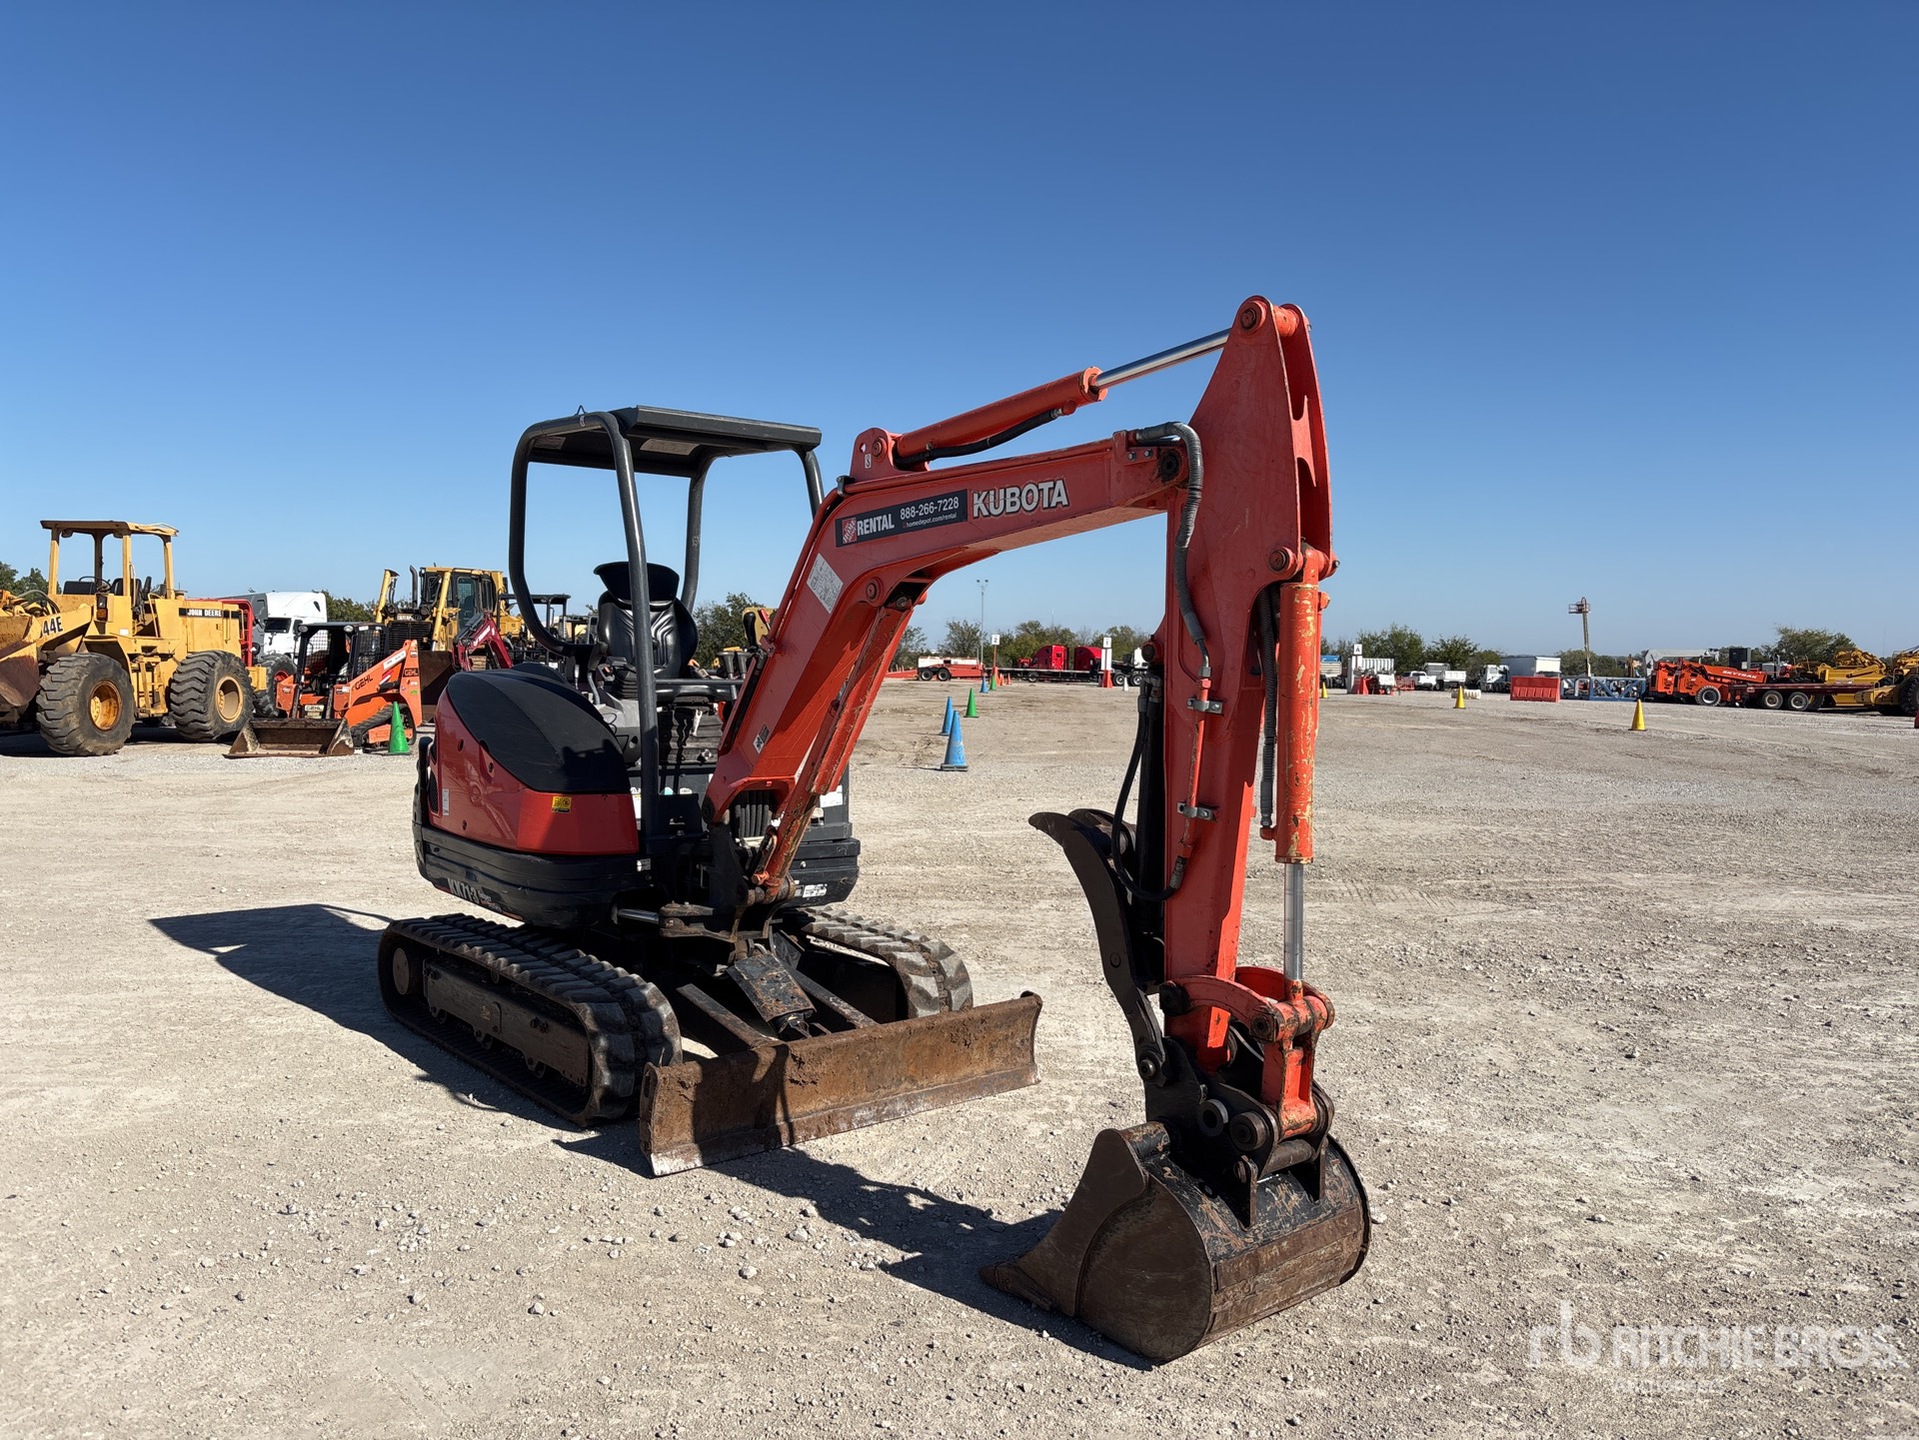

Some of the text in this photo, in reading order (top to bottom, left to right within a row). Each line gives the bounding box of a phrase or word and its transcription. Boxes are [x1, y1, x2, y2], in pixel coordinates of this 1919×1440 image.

[900, 496, 959, 520] 888-266-7228
[972, 479, 1069, 518] KUBOTA
[857, 513, 895, 536] RENTAL
[187, 608, 222, 617] JOHN DEERE
[354, 674, 374, 691] GEHL
[1722, 669, 1758, 679] SKYTRAK
